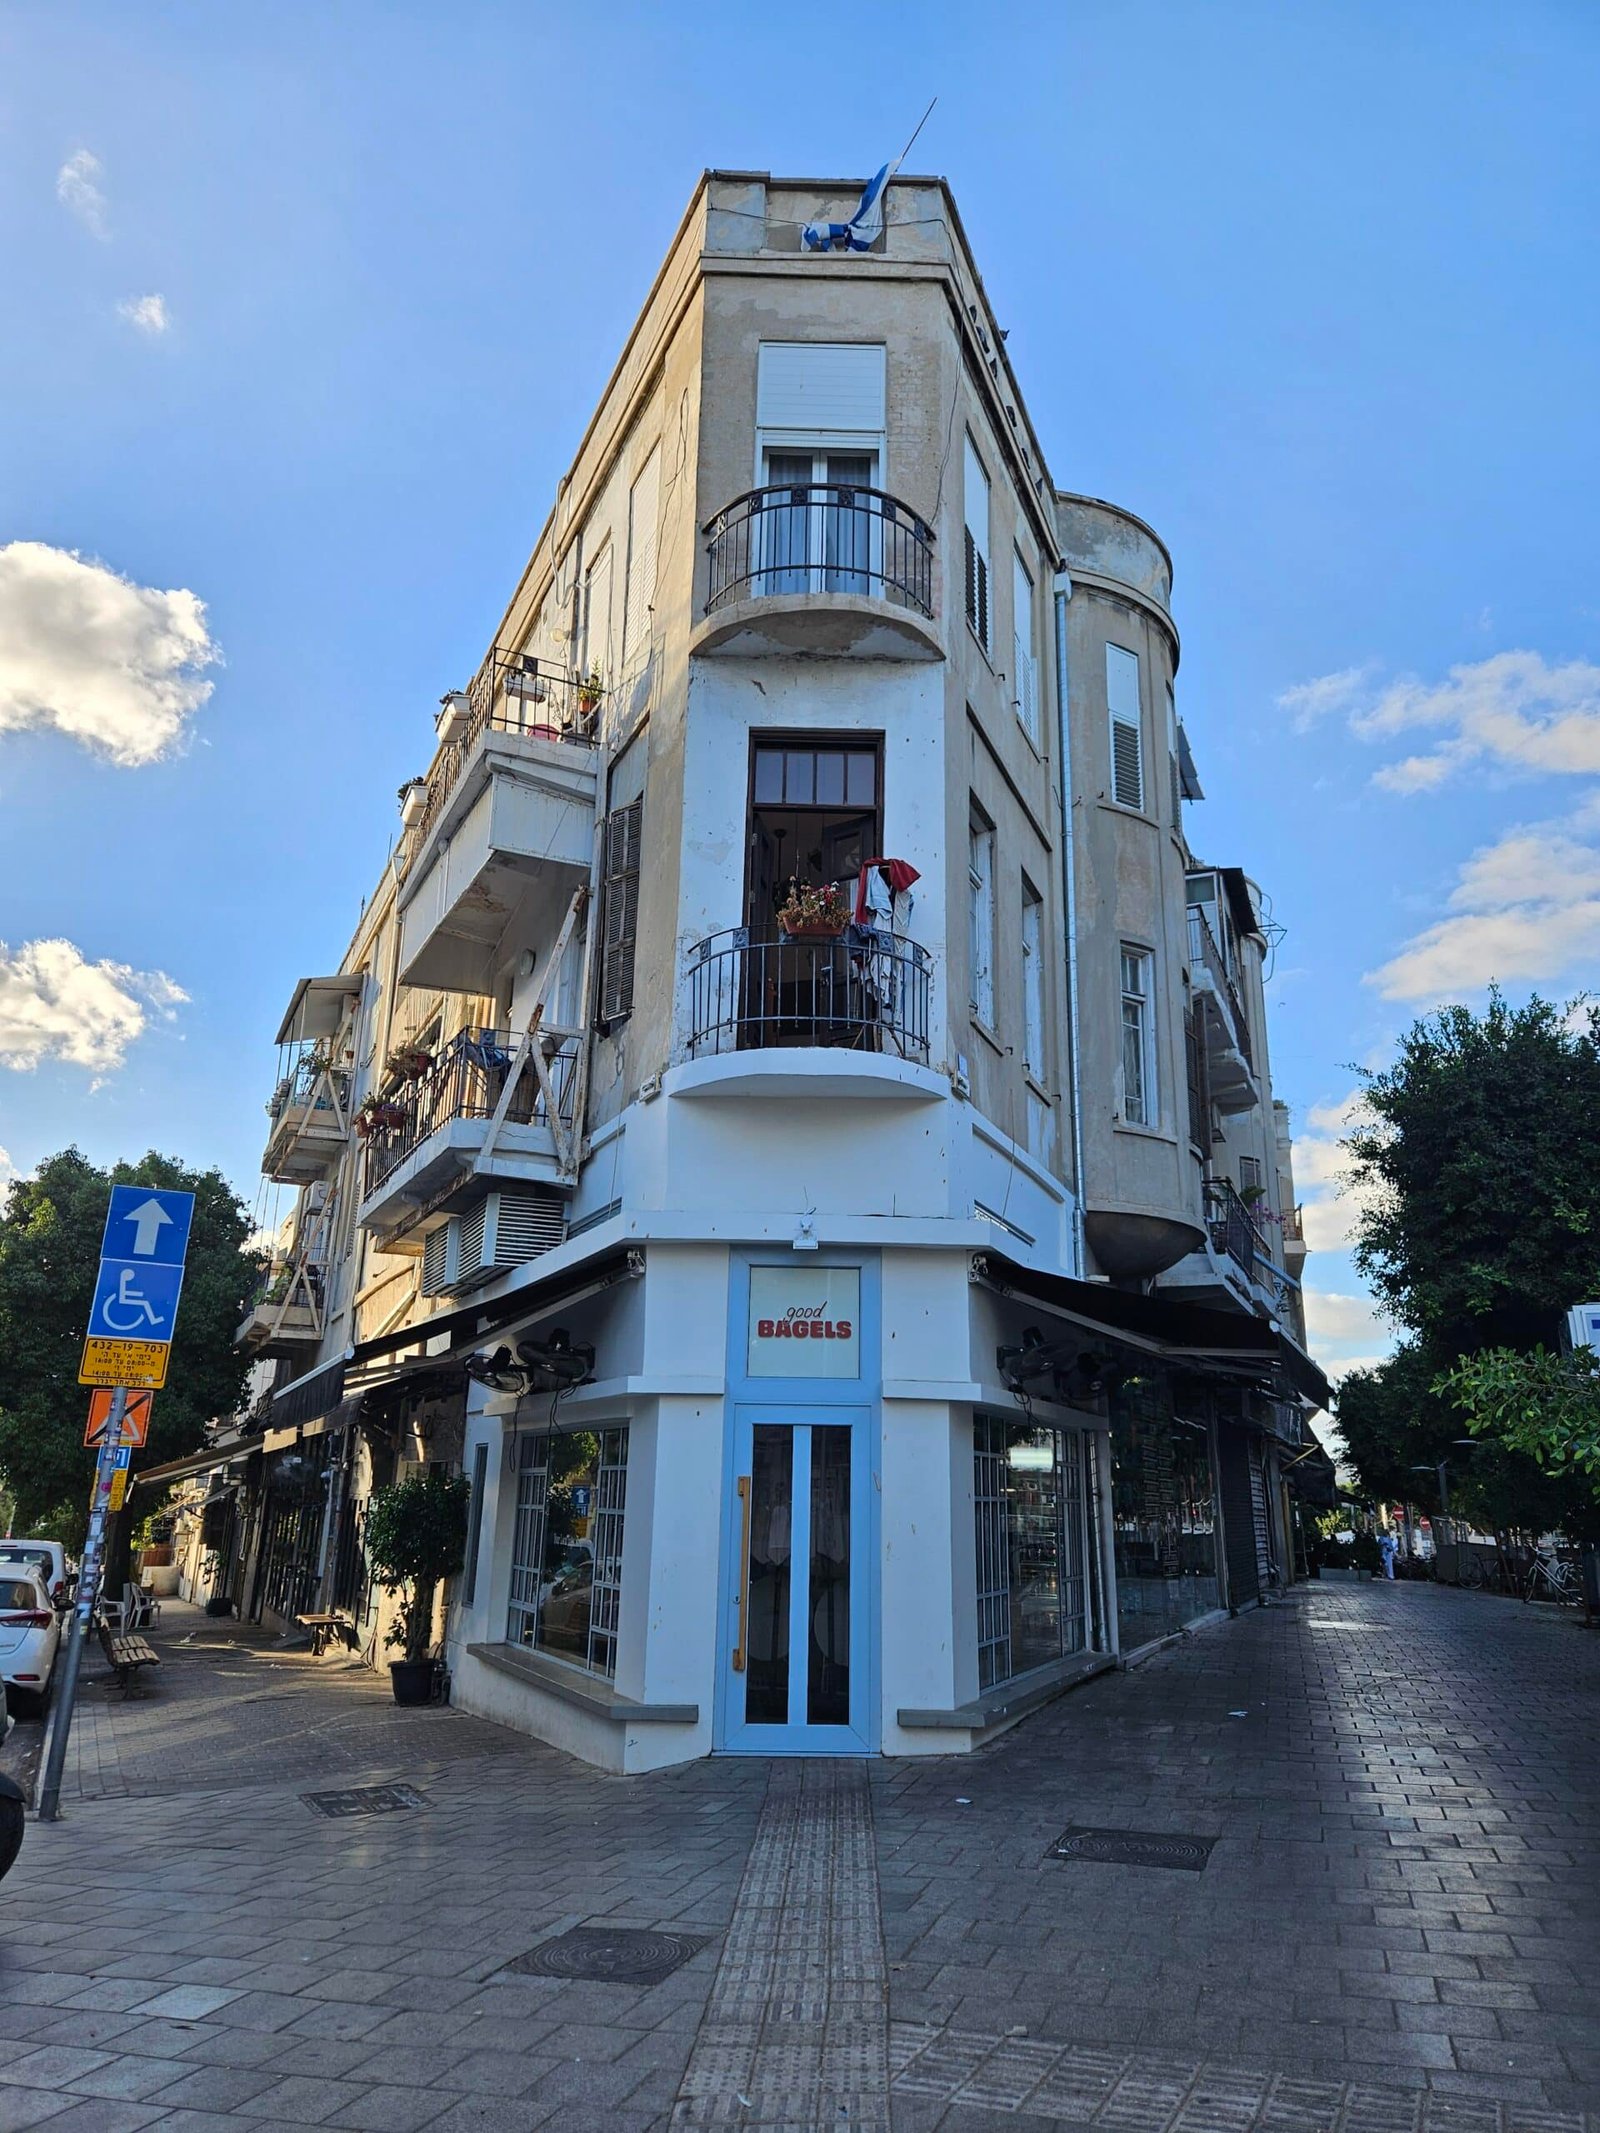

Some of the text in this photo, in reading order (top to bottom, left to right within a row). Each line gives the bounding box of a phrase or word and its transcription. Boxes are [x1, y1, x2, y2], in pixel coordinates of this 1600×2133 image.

[782, 1301, 828, 1325] good
[757, 1319, 852, 1339] BAGELS
[91, 1341, 164, 1353] 432-19-703
